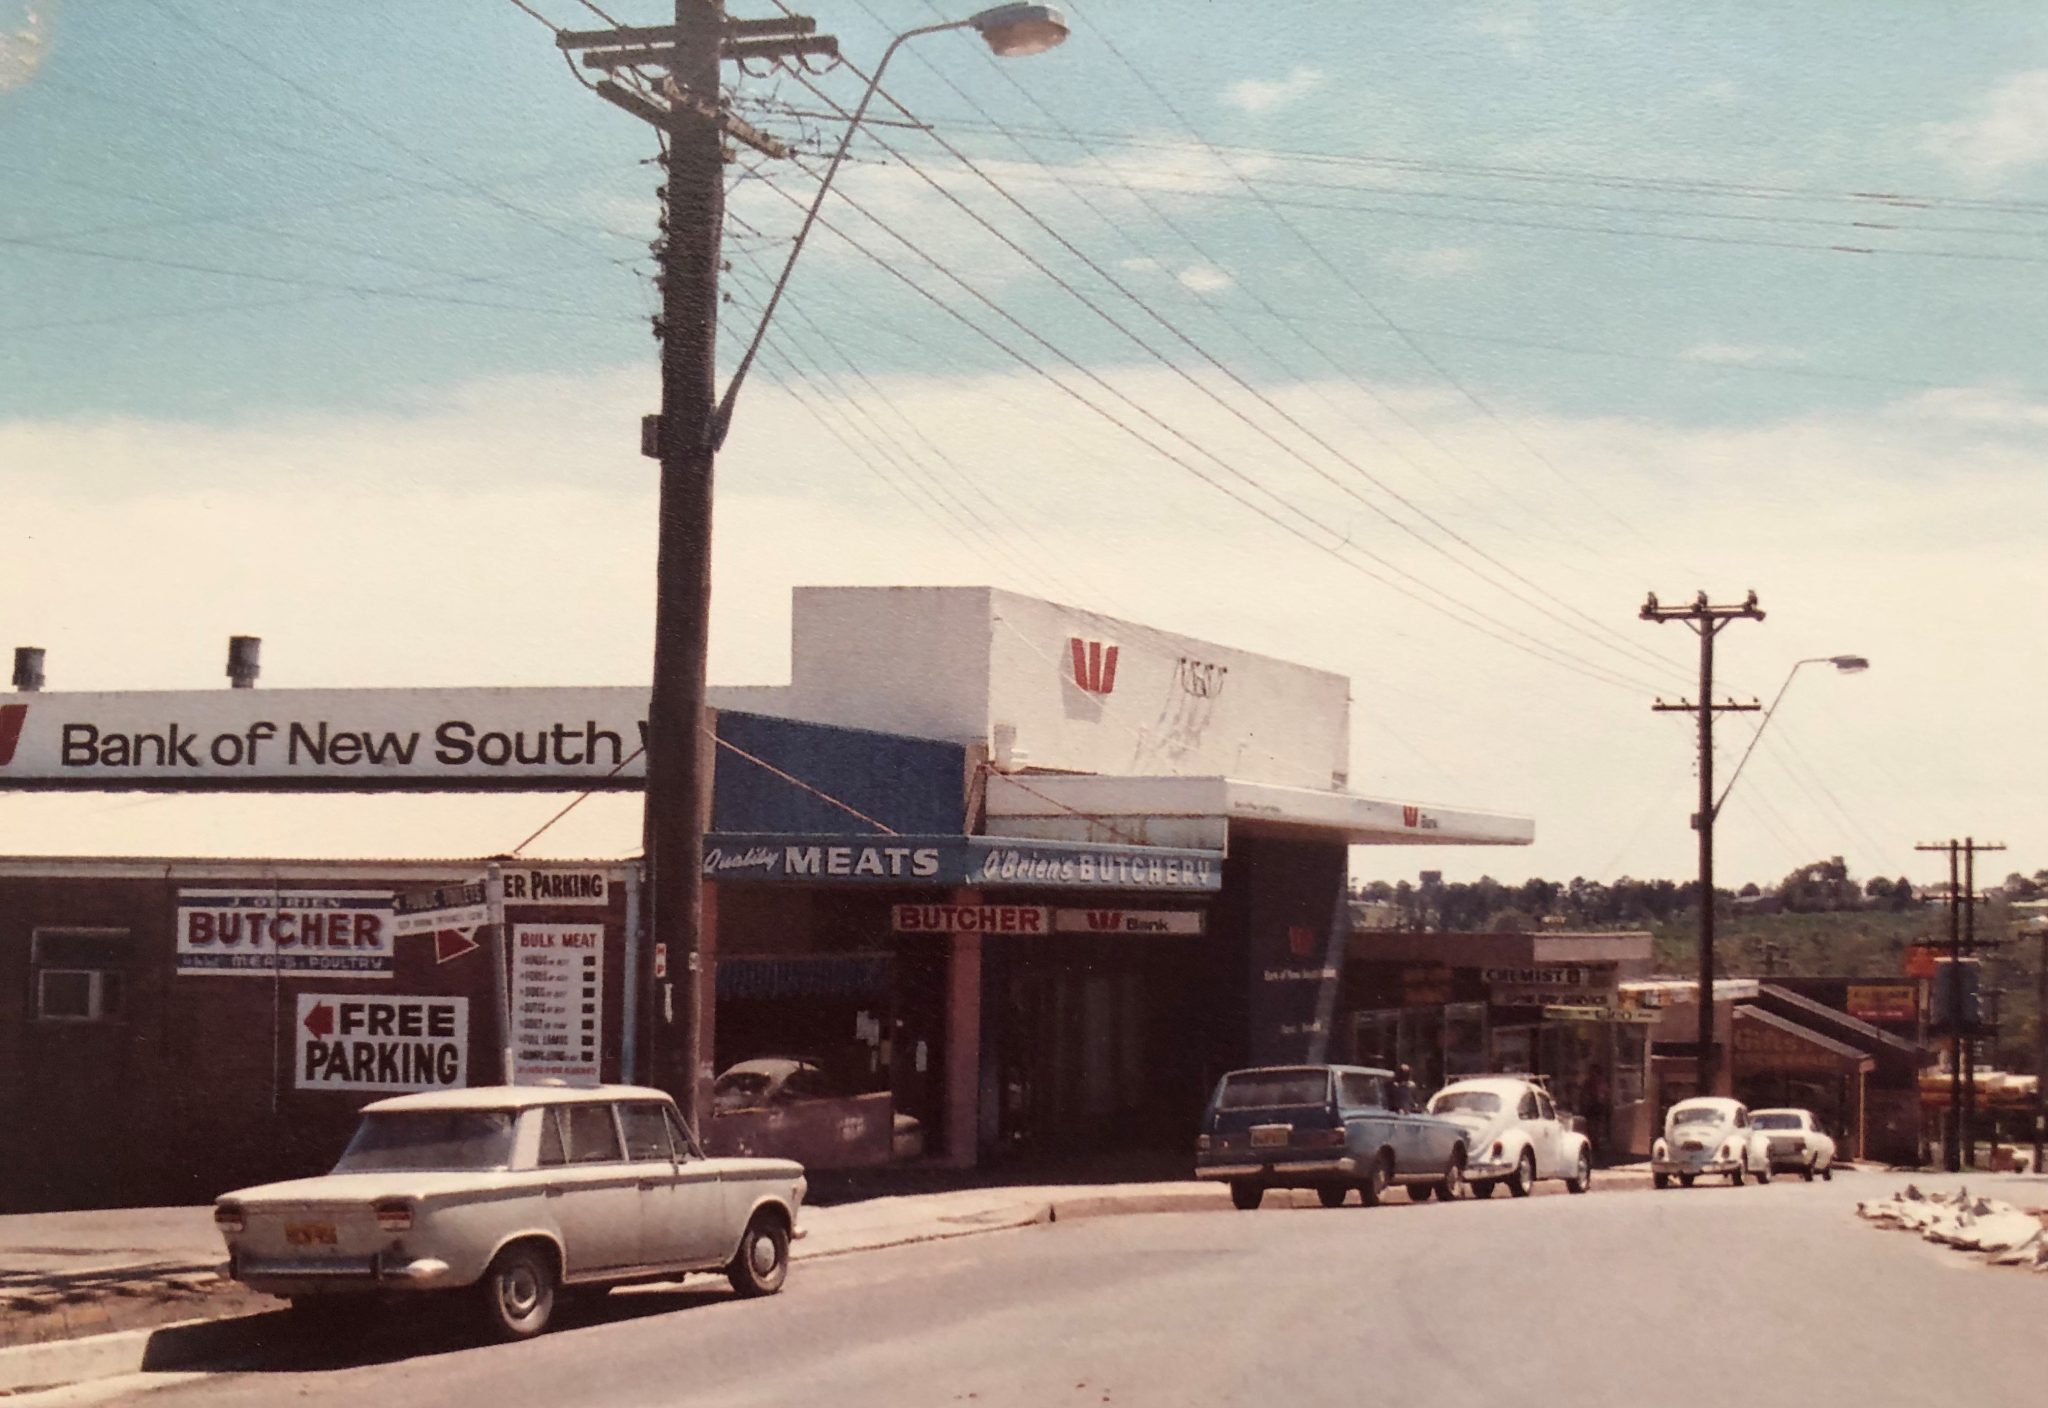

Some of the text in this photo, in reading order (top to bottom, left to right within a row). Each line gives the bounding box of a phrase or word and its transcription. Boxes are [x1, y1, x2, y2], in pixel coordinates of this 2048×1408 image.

[61, 722, 199, 767] Bank
[211, 720, 278, 767] of
[288, 720, 421, 766] New
[434, 720, 623, 766] South
[703, 846, 780, 874] Quality
[785, 845, 940, 877] MEATS
[1078, 853, 1212, 887] BUTCHERY
[530, 870, 604, 900] PARKING
[188, 911, 383, 949] BUTCHER
[900, 904, 1041, 932] BUTCHER
[1126, 917, 1169, 932] Bank
[520, 932, 597, 948] BULK MEAT
[308, 957, 384, 970] POULTRY
[339, 1002, 456, 1037] FREE
[304, 1040, 460, 1086] PARKING
